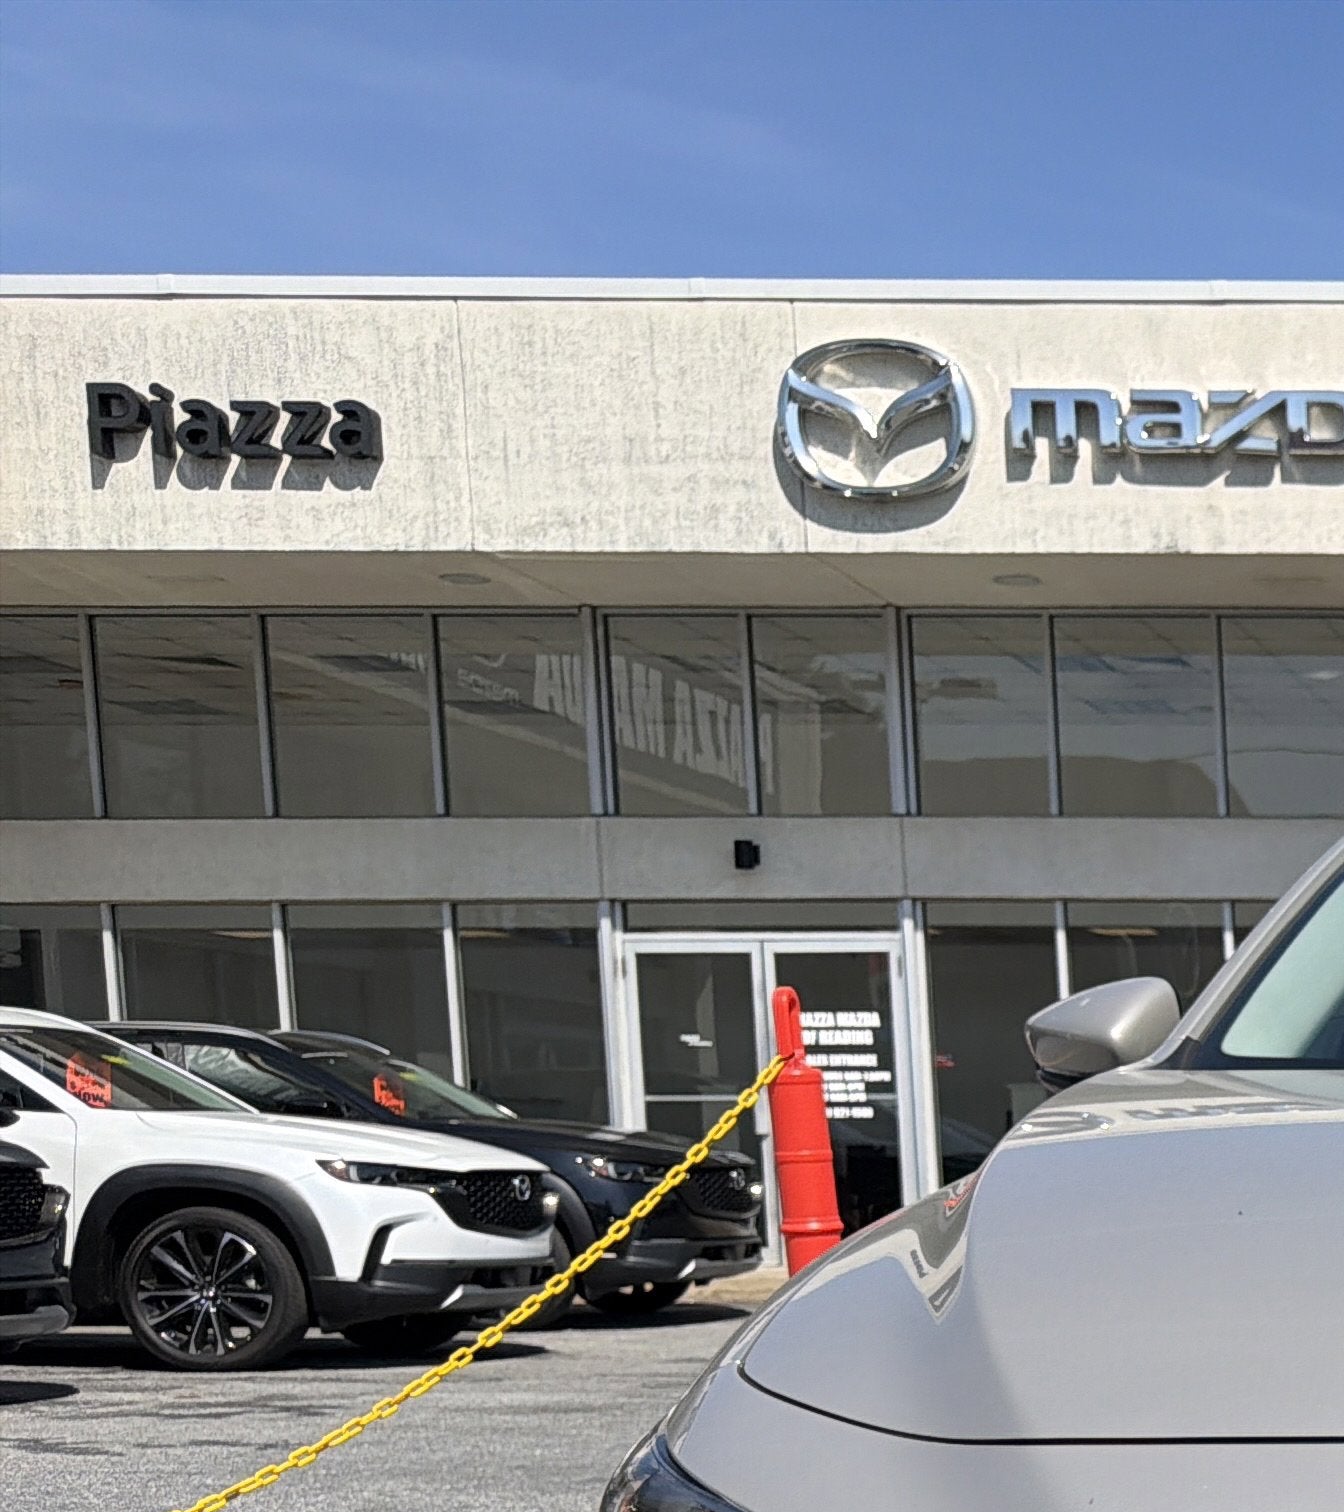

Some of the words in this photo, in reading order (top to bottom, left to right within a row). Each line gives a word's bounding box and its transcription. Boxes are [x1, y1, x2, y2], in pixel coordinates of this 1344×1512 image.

[86, 381, 384, 459] Piazza
[799, 1011, 836, 1028] IAZZA
[818, 1029, 874, 1046] READING
